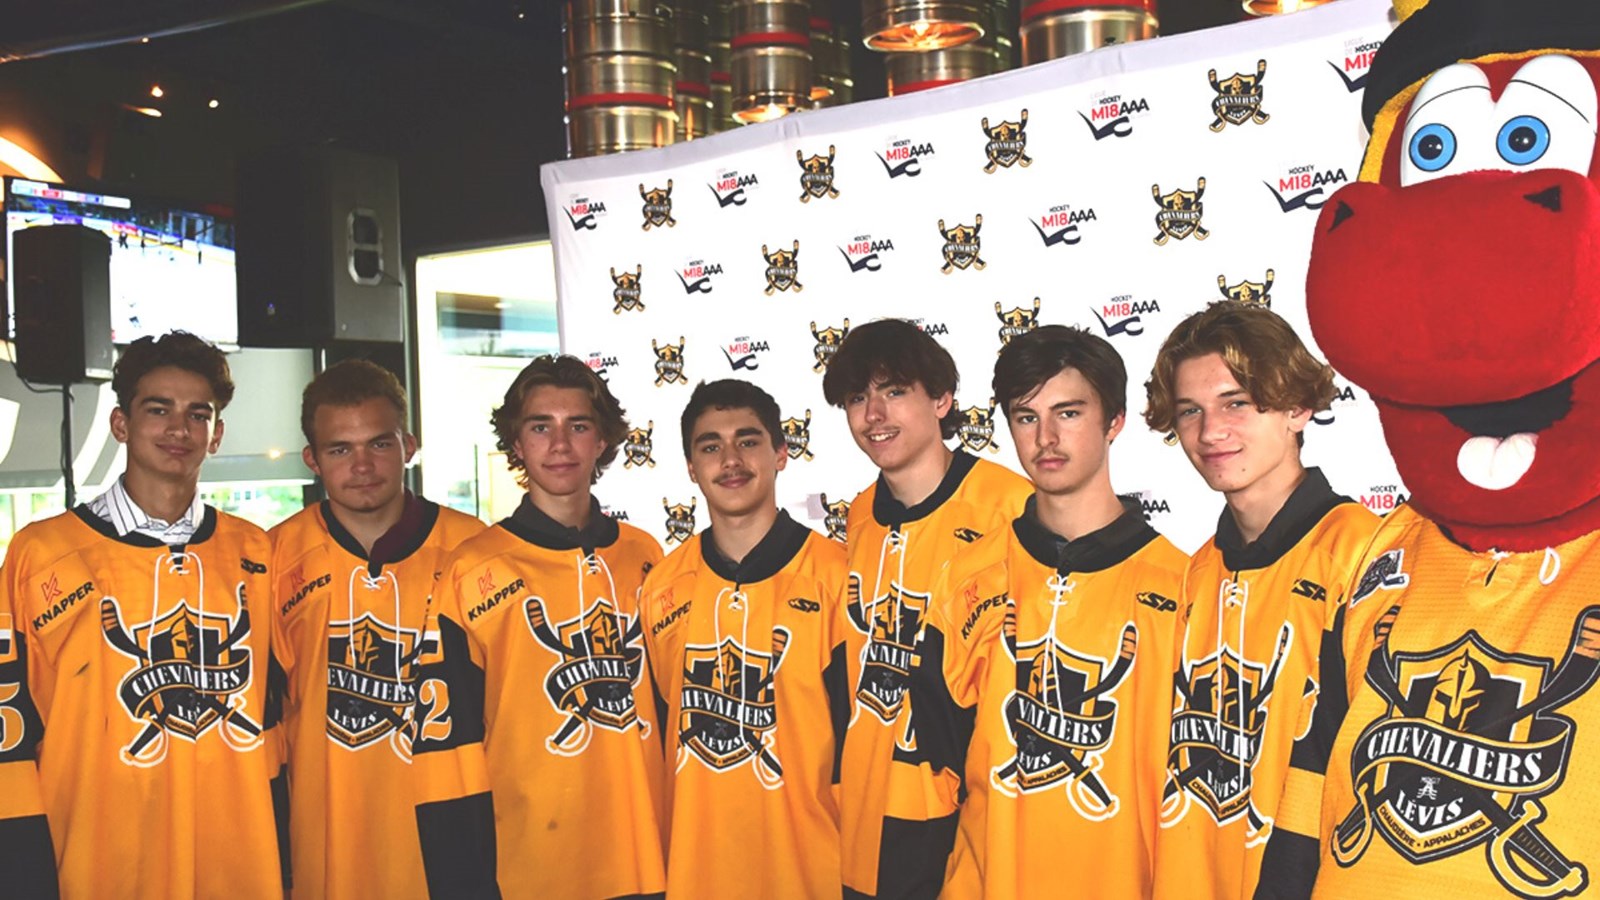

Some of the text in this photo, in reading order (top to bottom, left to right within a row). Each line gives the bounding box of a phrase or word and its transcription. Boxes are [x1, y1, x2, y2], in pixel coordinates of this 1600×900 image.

[1091, 98, 1150, 121] M18AAA
[886, 142, 935, 161] M18AAA
[716, 173, 759, 192] M18AAA
[1279, 168, 1348, 193] M18AAA
[570, 201, 606, 217] M18AAA
[1041, 208, 1098, 228] M18AAA
[847, 239, 895, 255] M18AAA
[683, 263, 724, 279] M18AAA
[1103, 299, 1161, 318] M18AAA
[729, 340, 770, 354] M18AAA
[31, 581, 95, 632] KNAPPER
[467, 577, 526, 622] KNAPPER
[419, 679, 453, 741] 2
[681, 689, 773, 727] HEVALIERS
[1018, 697, 1103, 745] VALIERS
[1366, 726, 1544, 785] CHEVALIERS
[1395, 788, 1464, 826] LÉVIS
[1423, 817, 1487, 849] APPALACHES
